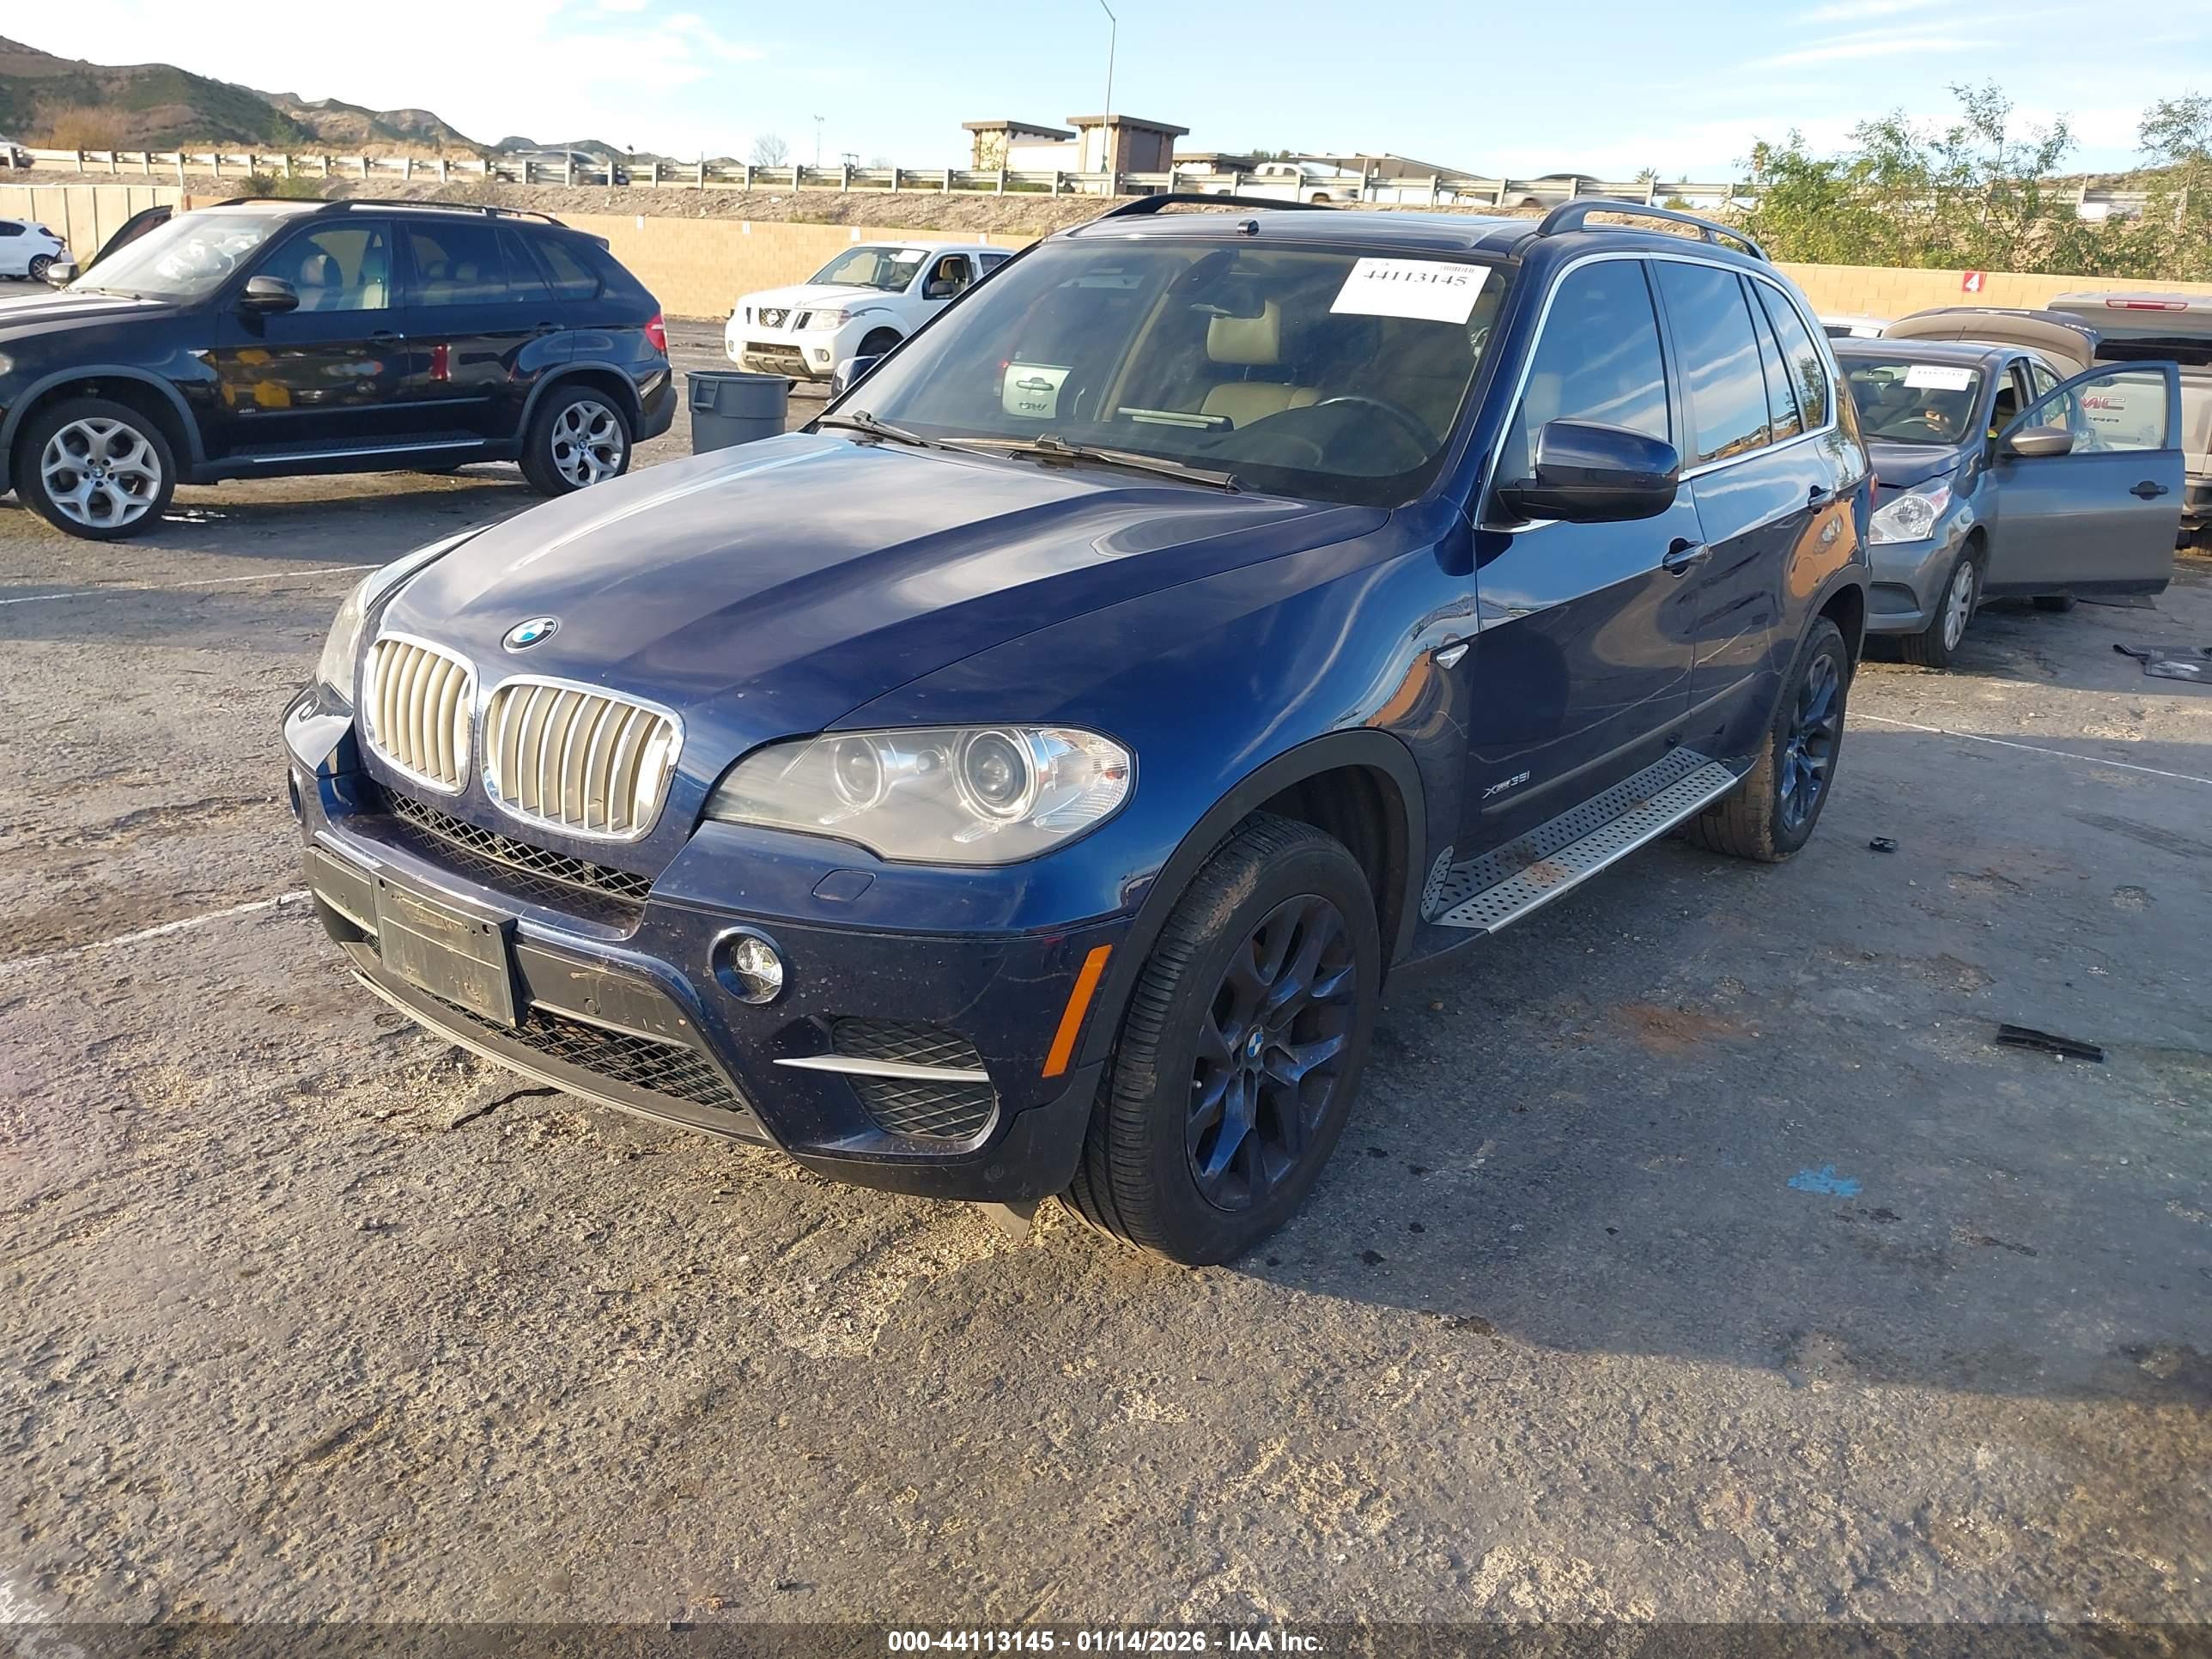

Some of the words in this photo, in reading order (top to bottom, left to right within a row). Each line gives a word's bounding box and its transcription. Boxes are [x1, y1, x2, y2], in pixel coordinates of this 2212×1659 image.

[1364, 270, 1469, 286] 44113145
[1966, 273, 1979, 292] 4
[2081, 396, 2126, 411] MC
